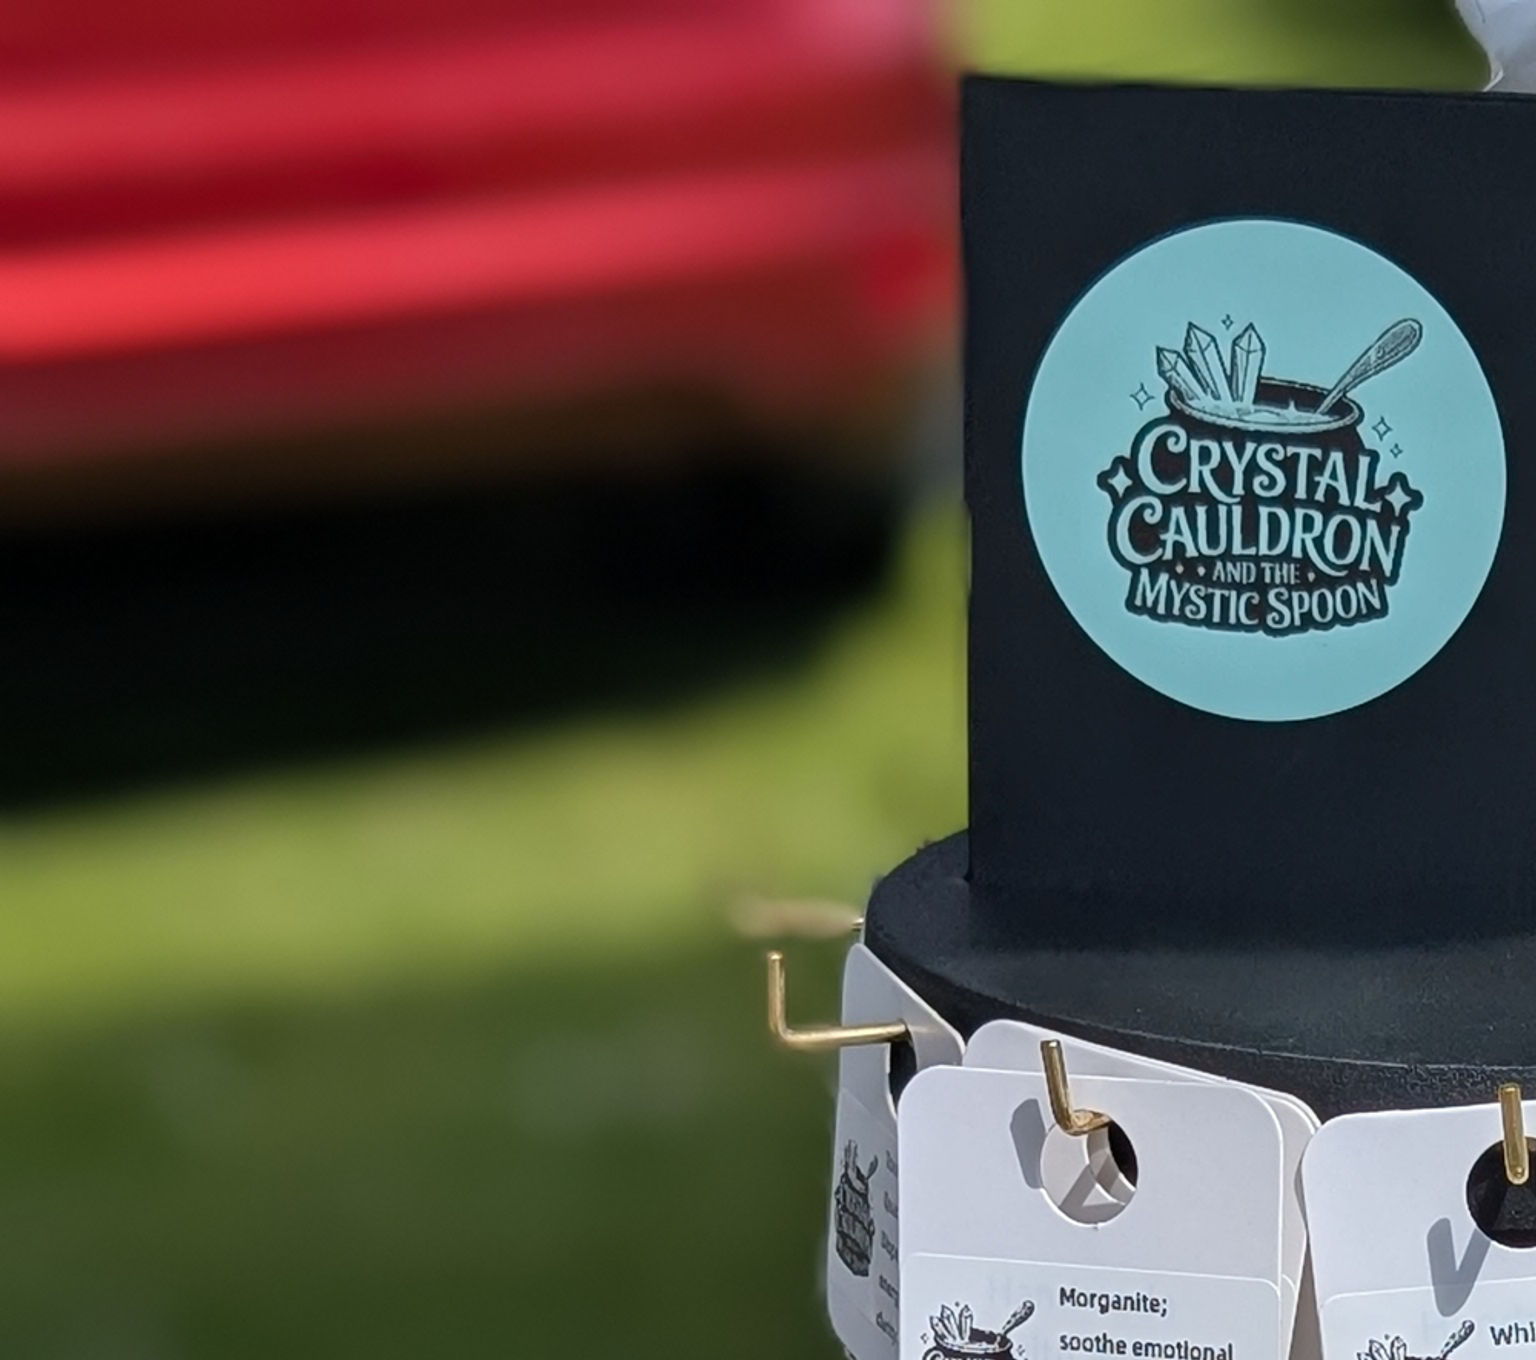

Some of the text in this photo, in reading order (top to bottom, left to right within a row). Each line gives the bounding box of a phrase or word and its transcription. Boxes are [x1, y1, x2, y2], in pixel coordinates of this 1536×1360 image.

[1137, 423, 1382, 512] CRYSTAL
[1116, 495, 1401, 577] CAULDRON
[1212, 561, 1301, 584] AND THE
[1134, 567, 1380, 629] MYSTIC SPOON
[1059, 1286, 1168, 1317] Morganite;
[1059, 1332, 1126, 1356] soothe
